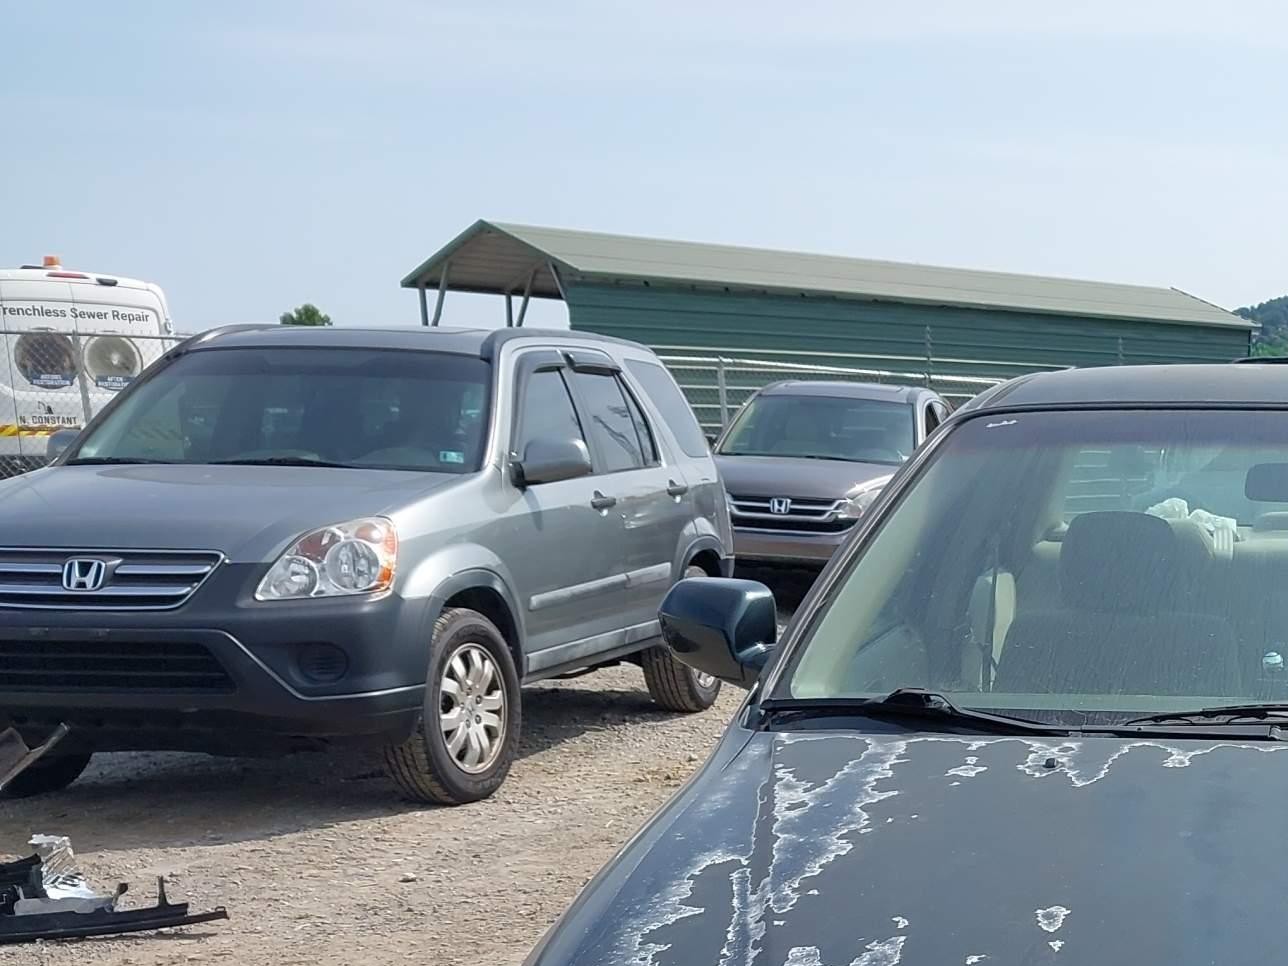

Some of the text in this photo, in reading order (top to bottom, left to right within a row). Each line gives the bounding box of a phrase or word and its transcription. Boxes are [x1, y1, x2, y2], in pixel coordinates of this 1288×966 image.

[70, 307, 109, 320] Sewer
[112, 310, 150, 324] Repair
[32, 415, 77, 425] CONSTANT
